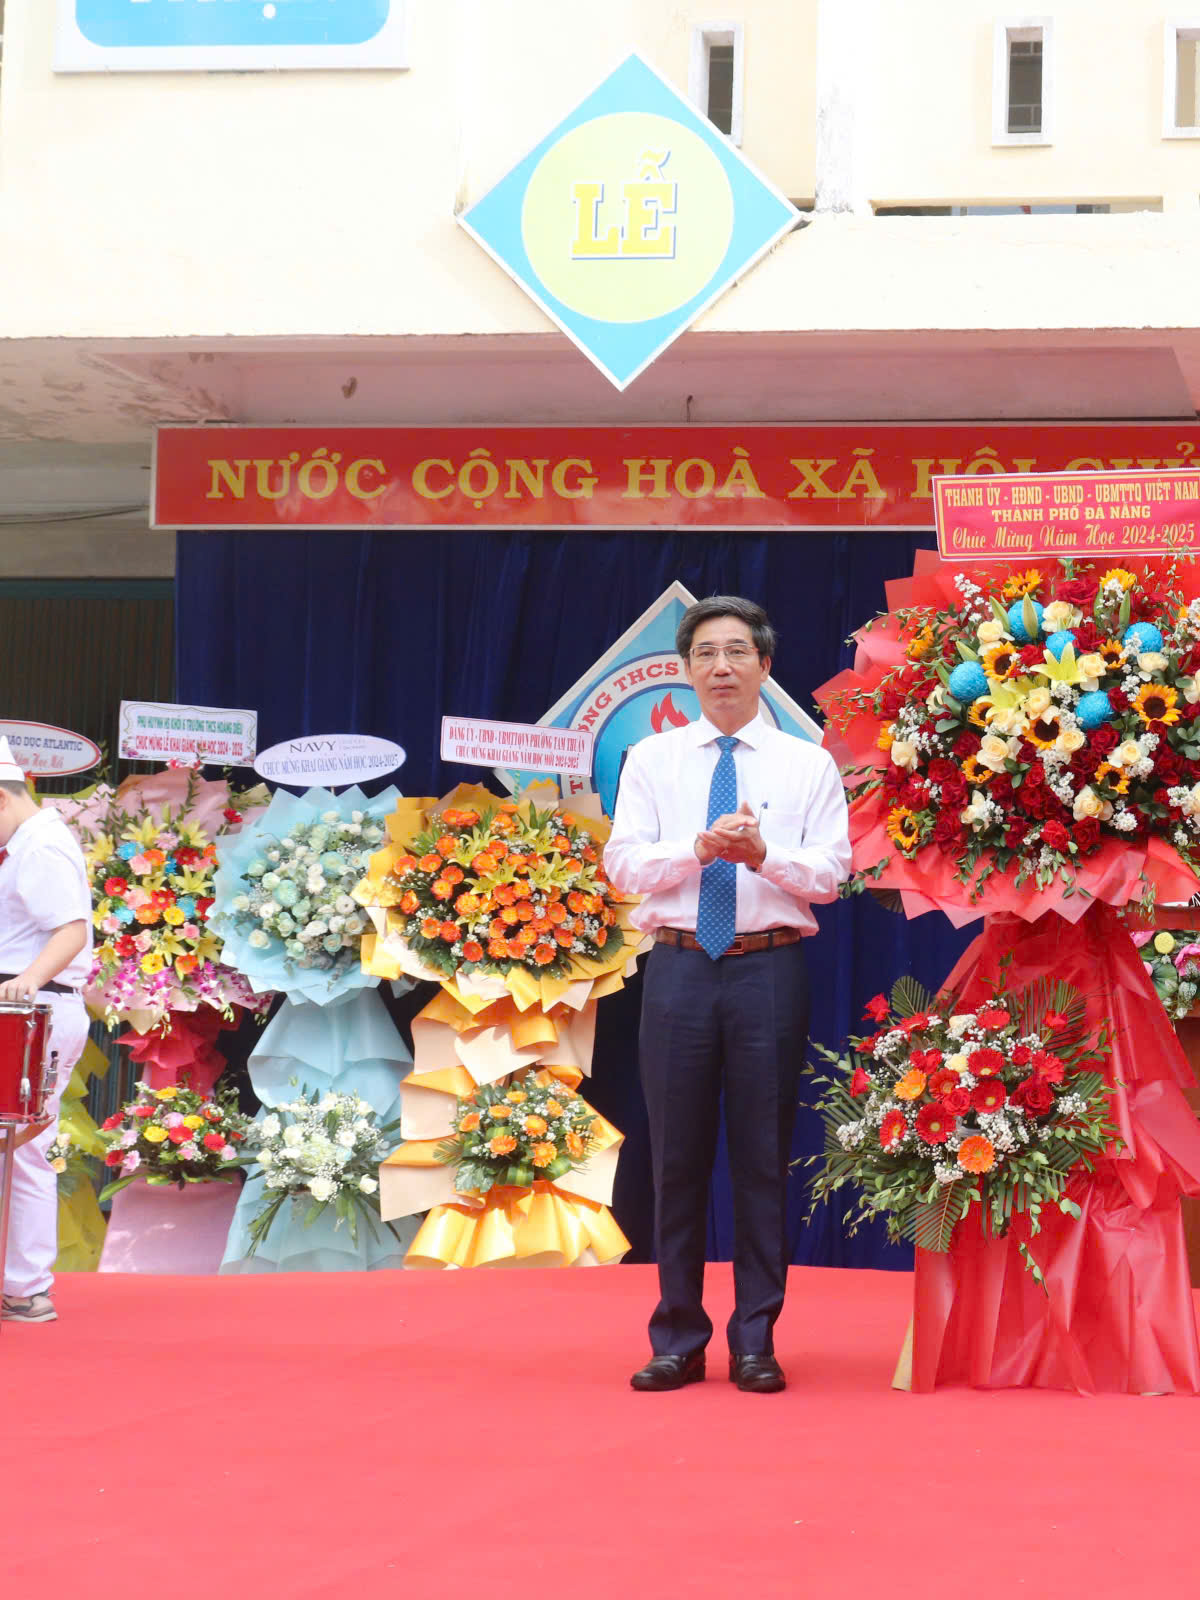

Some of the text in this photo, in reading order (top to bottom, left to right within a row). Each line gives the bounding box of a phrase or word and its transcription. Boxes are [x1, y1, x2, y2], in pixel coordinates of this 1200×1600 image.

[571, 146, 677, 260] LỄ
[205, 447, 388, 499] NƯỚC
[412, 447, 599, 509] CỘNG
[622, 446, 765, 499] HOÀ
[789, 448, 886, 499] XÃ
[1011, 486, 1042, 505] HĐND
[1053, 485, 1084, 504] UBND
[1095, 483, 1142, 503] UBMTTQ
[1144, 478, 1171, 504] VIỆT
[1174, 481, 1199, 500] NAM
[992, 506, 1043, 522] THÀNH
[1049, 503, 1079, 521] PHỐ
[1085, 504, 1105, 520] ĐÀ
[992, 526, 1033, 552] Mừng
[1040, 525, 1078, 547] Năm
[1085, 523, 1115, 550] Học
[1121, 523, 1195, 545] 2024-2025
[613, 661, 680, 692] THCS
[43, 738, 83, 751] ATLANTIC
[290, 741, 336, 753] NAVY
